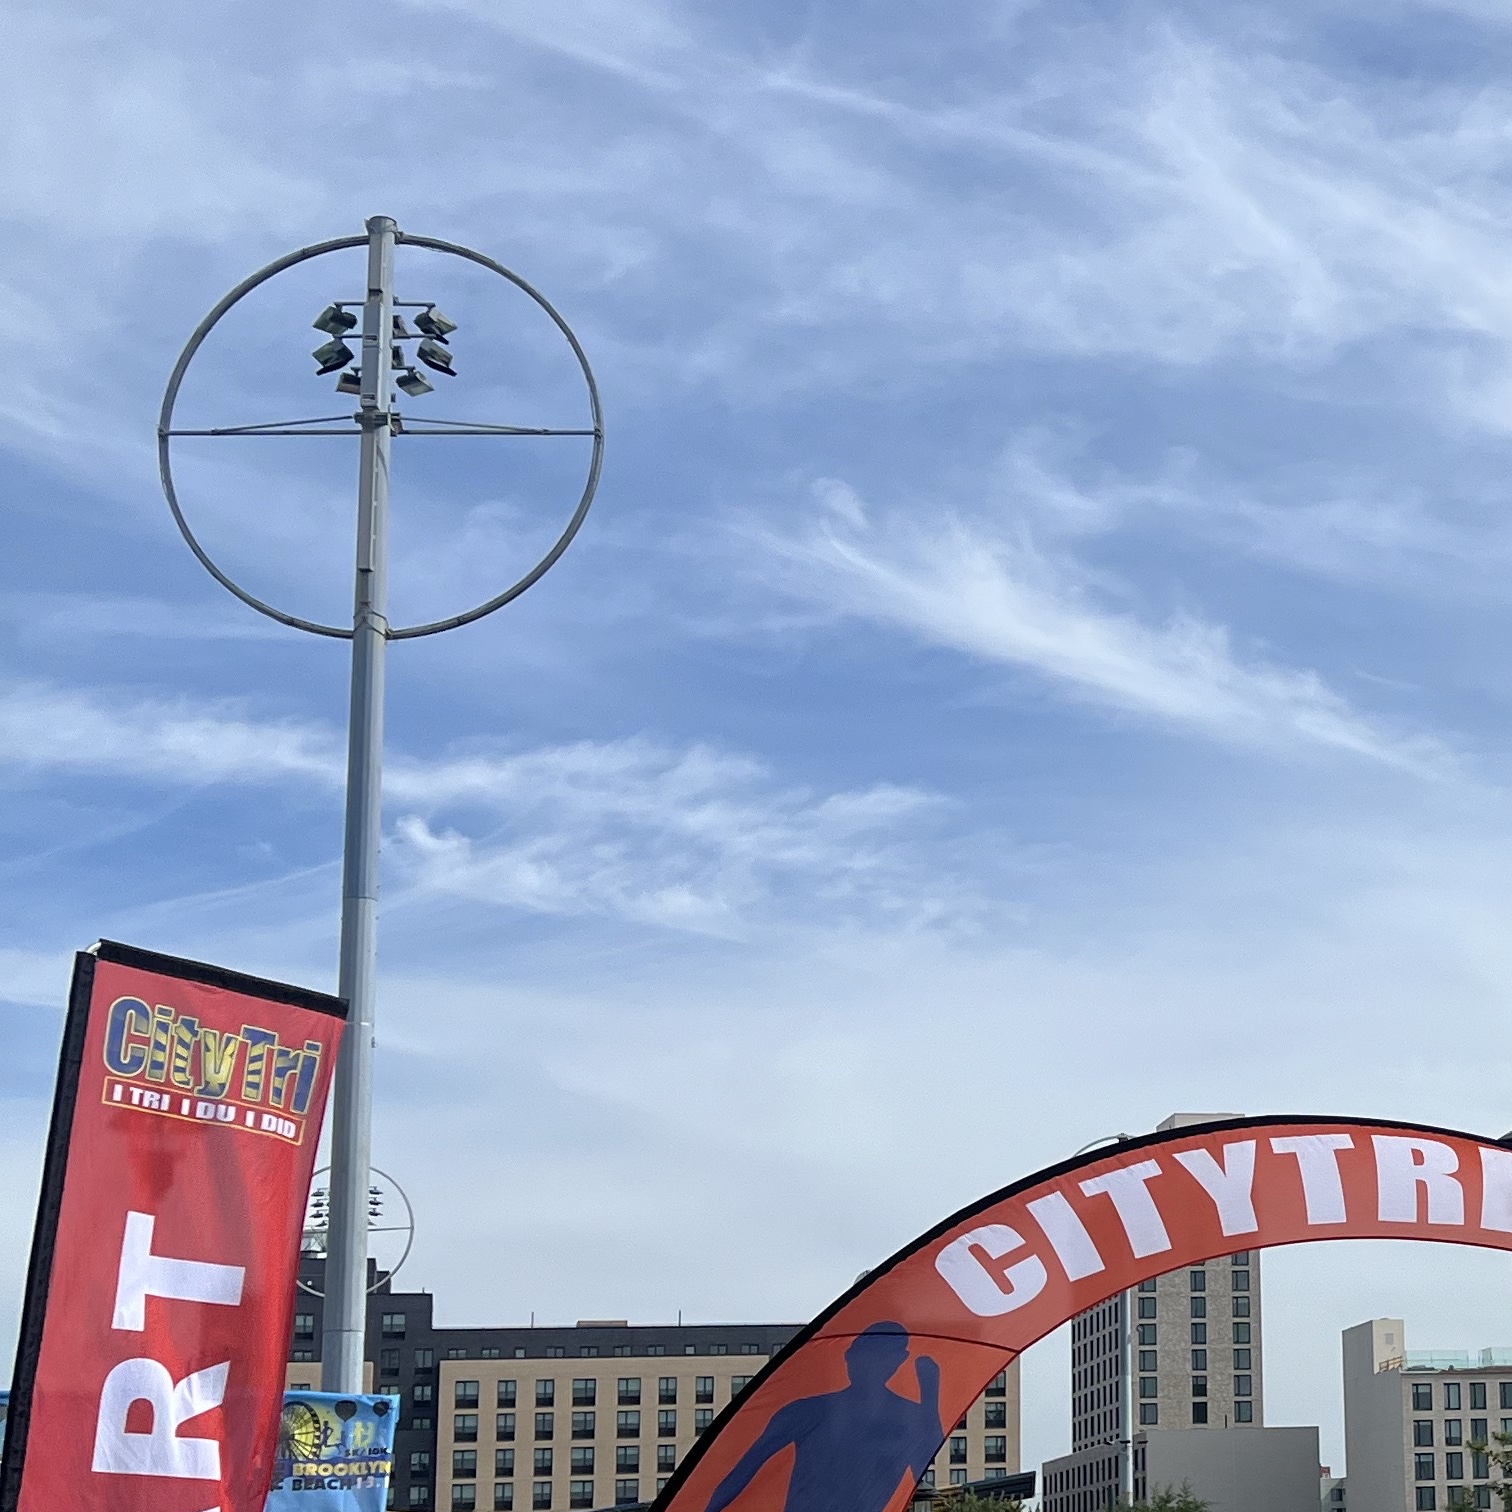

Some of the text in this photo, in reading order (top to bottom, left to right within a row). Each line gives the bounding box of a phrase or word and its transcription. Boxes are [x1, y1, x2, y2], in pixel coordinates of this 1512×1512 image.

[103, 996, 323, 1115] CityTri
[112, 1084, 296, 1139] I TRI I DU I DID
[292, 1460, 391, 1477] BROOKLYN
[292, 1478, 352, 1491] BEACH
